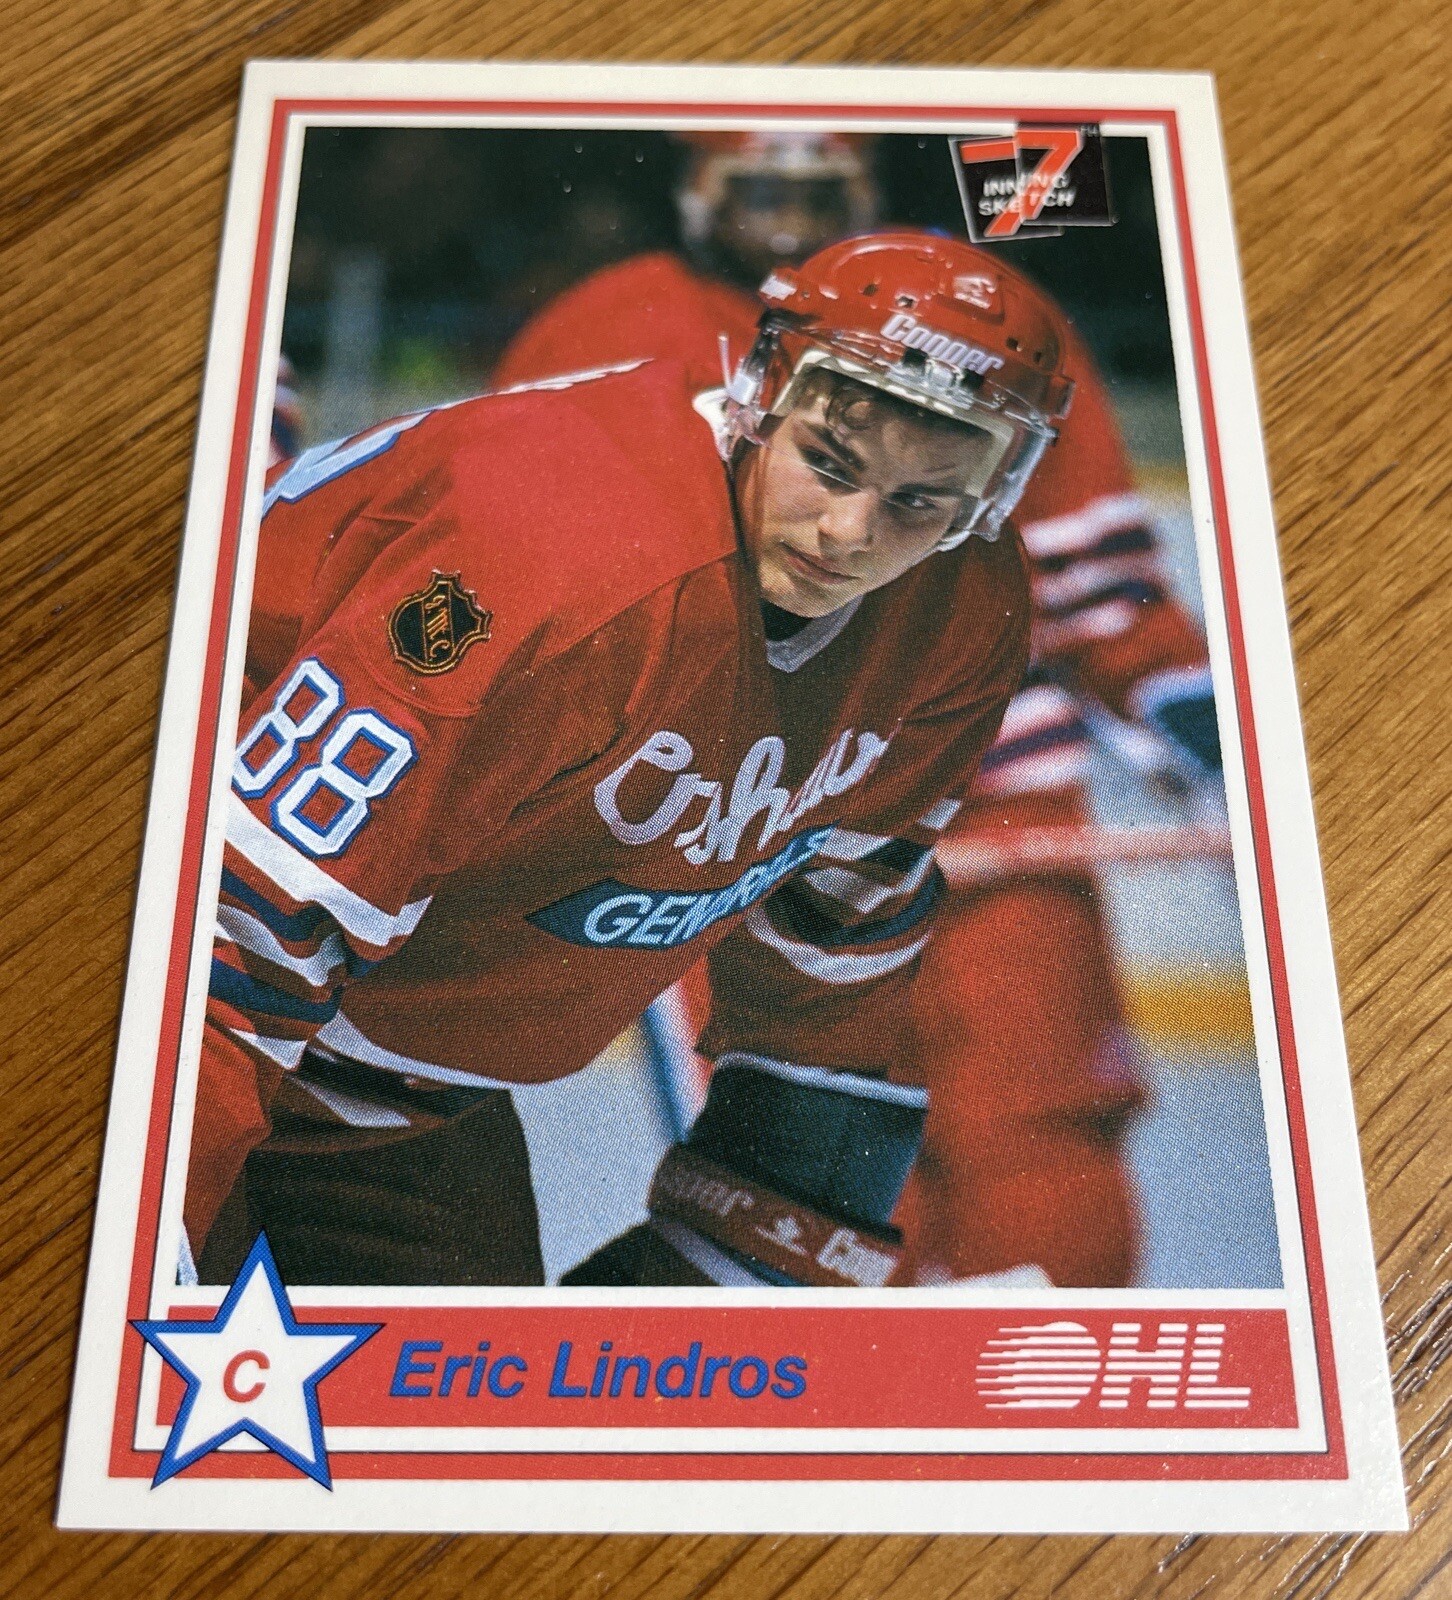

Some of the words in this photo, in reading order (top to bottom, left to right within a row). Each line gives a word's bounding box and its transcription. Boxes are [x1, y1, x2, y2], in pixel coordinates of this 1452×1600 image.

[978, 188, 1077, 216] SKETCH
[982, 172, 1070, 198] INNING
[231, 655, 420, 860] 88
[223, 1350, 270, 1403] C
[388, 1341, 528, 1398] Eric
[548, 1341, 808, 1399] Lindros
[975, 1320, 1251, 1409] OHL
